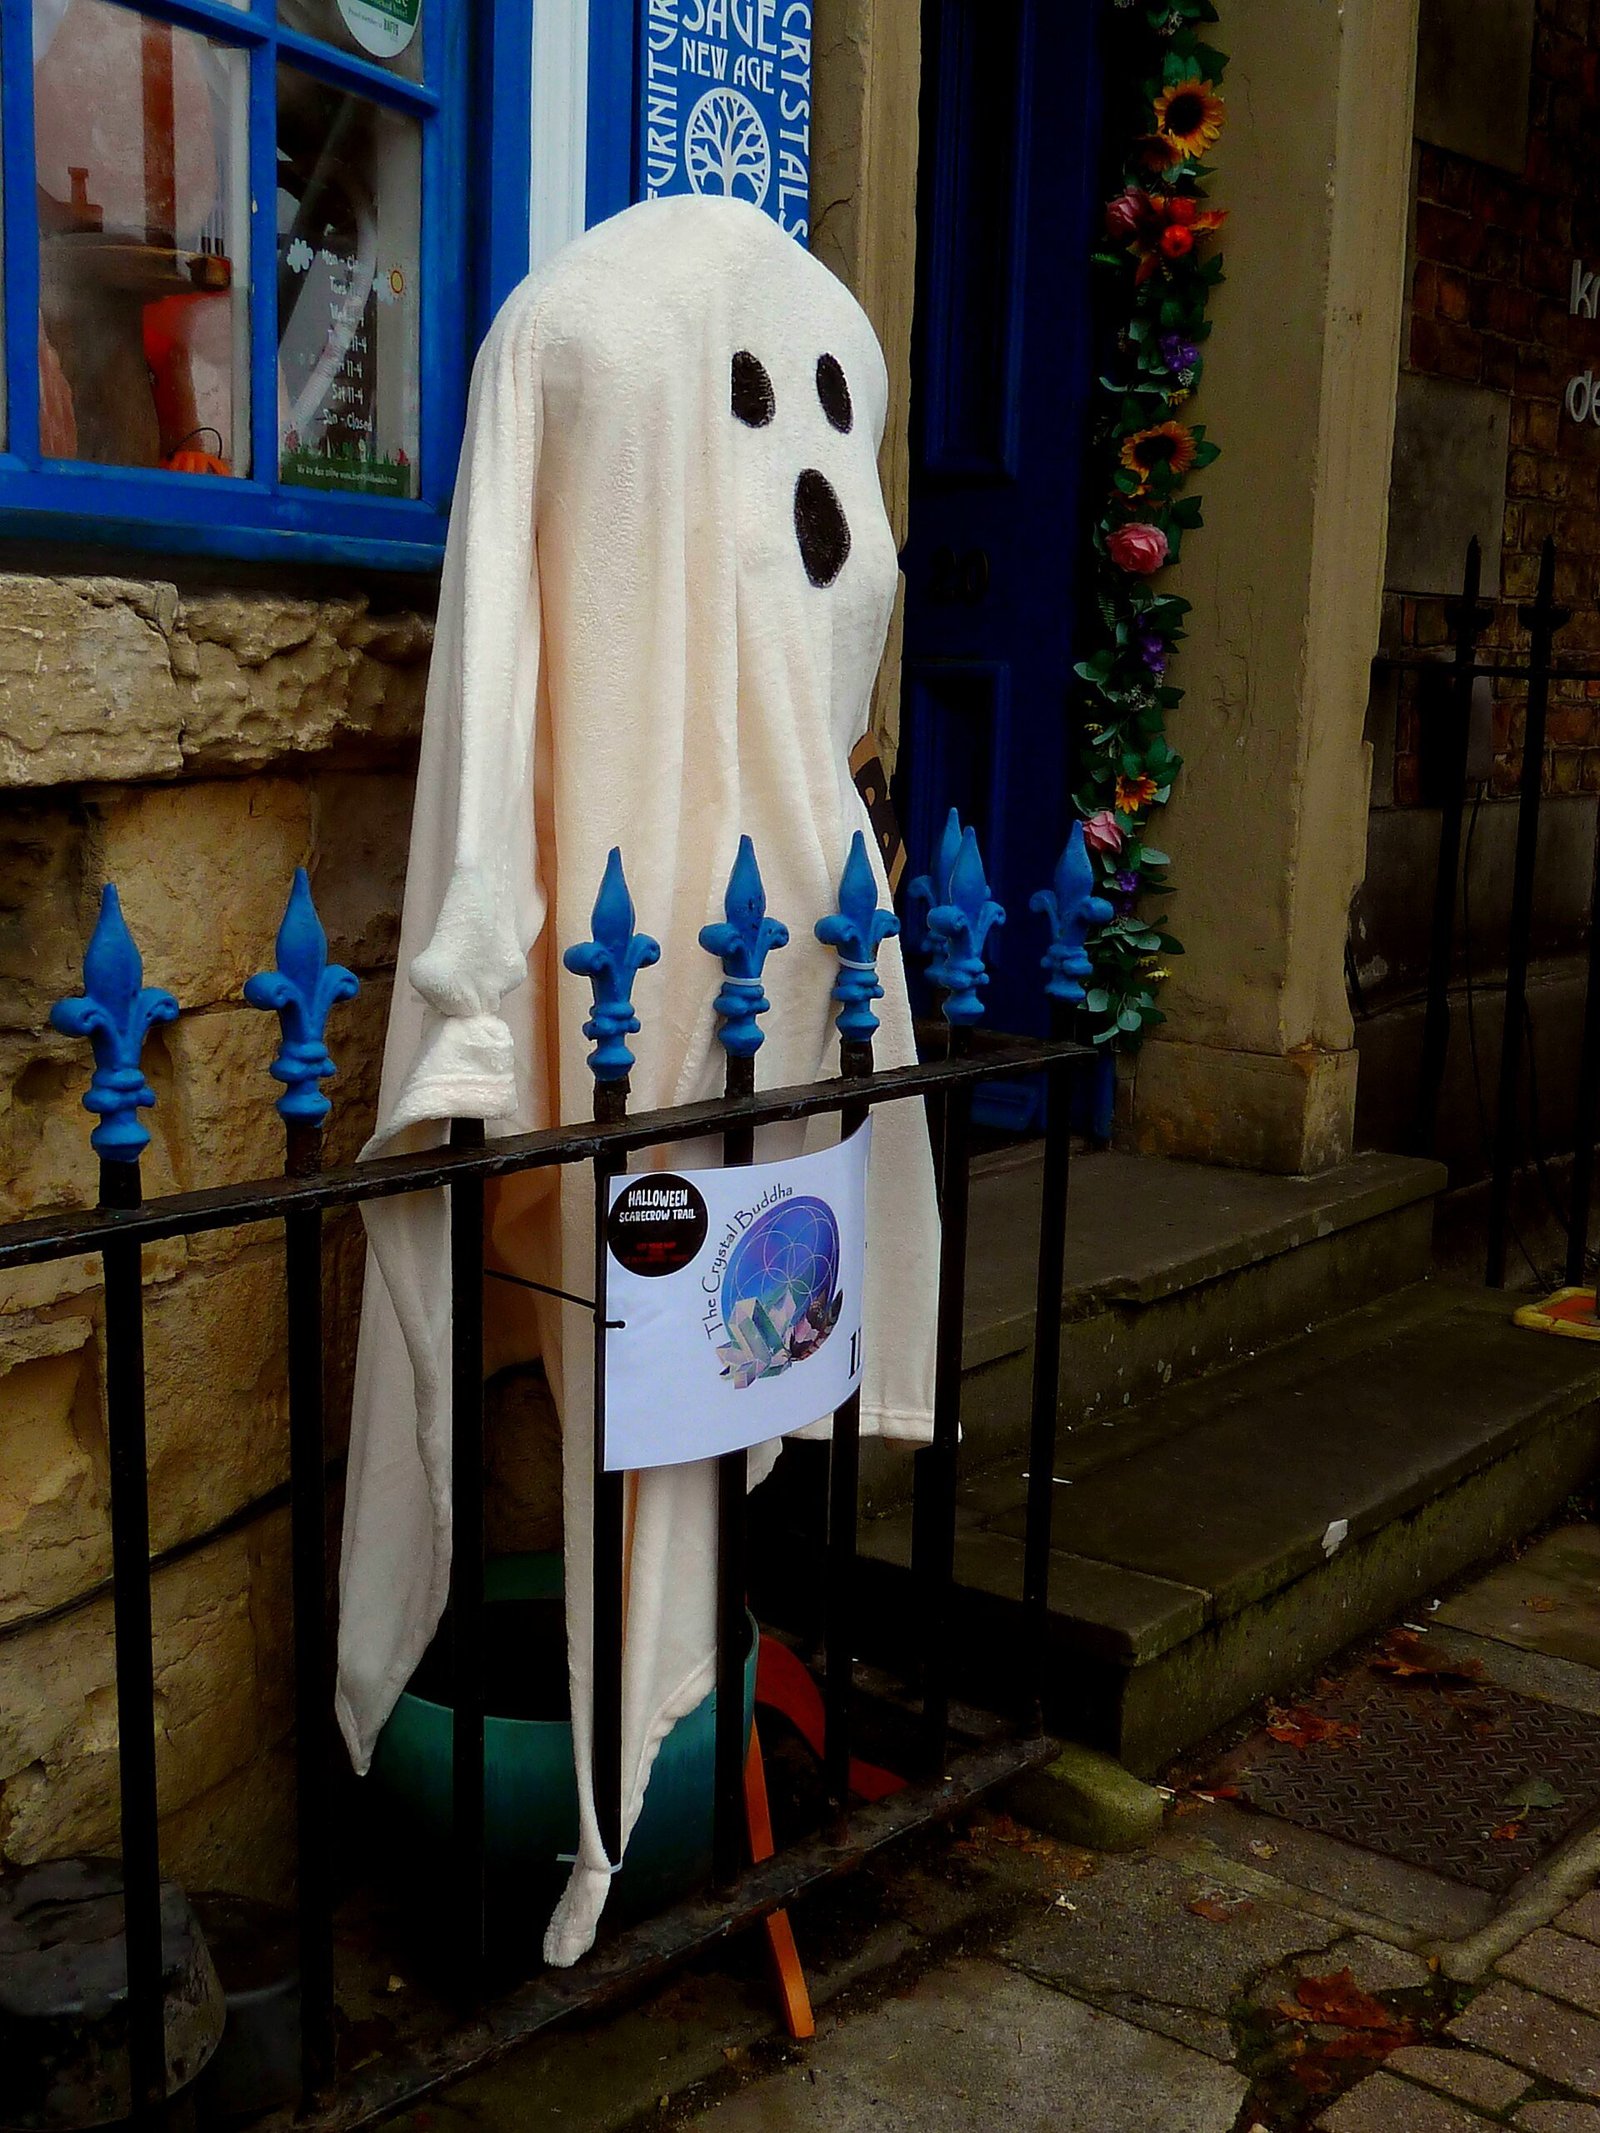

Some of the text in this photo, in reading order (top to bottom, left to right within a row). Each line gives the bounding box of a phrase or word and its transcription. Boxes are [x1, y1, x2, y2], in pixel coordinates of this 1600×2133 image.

[682, 37, 775, 95] NEW AGE
[778, 2, 811, 238] CRYSTALS
[618, 1208, 697, 1223] SCARECROW TRAIL
[627, 1188, 688, 1208] HALLOWEEN
[702, 1183, 792, 1340] The Crystal Buddha
